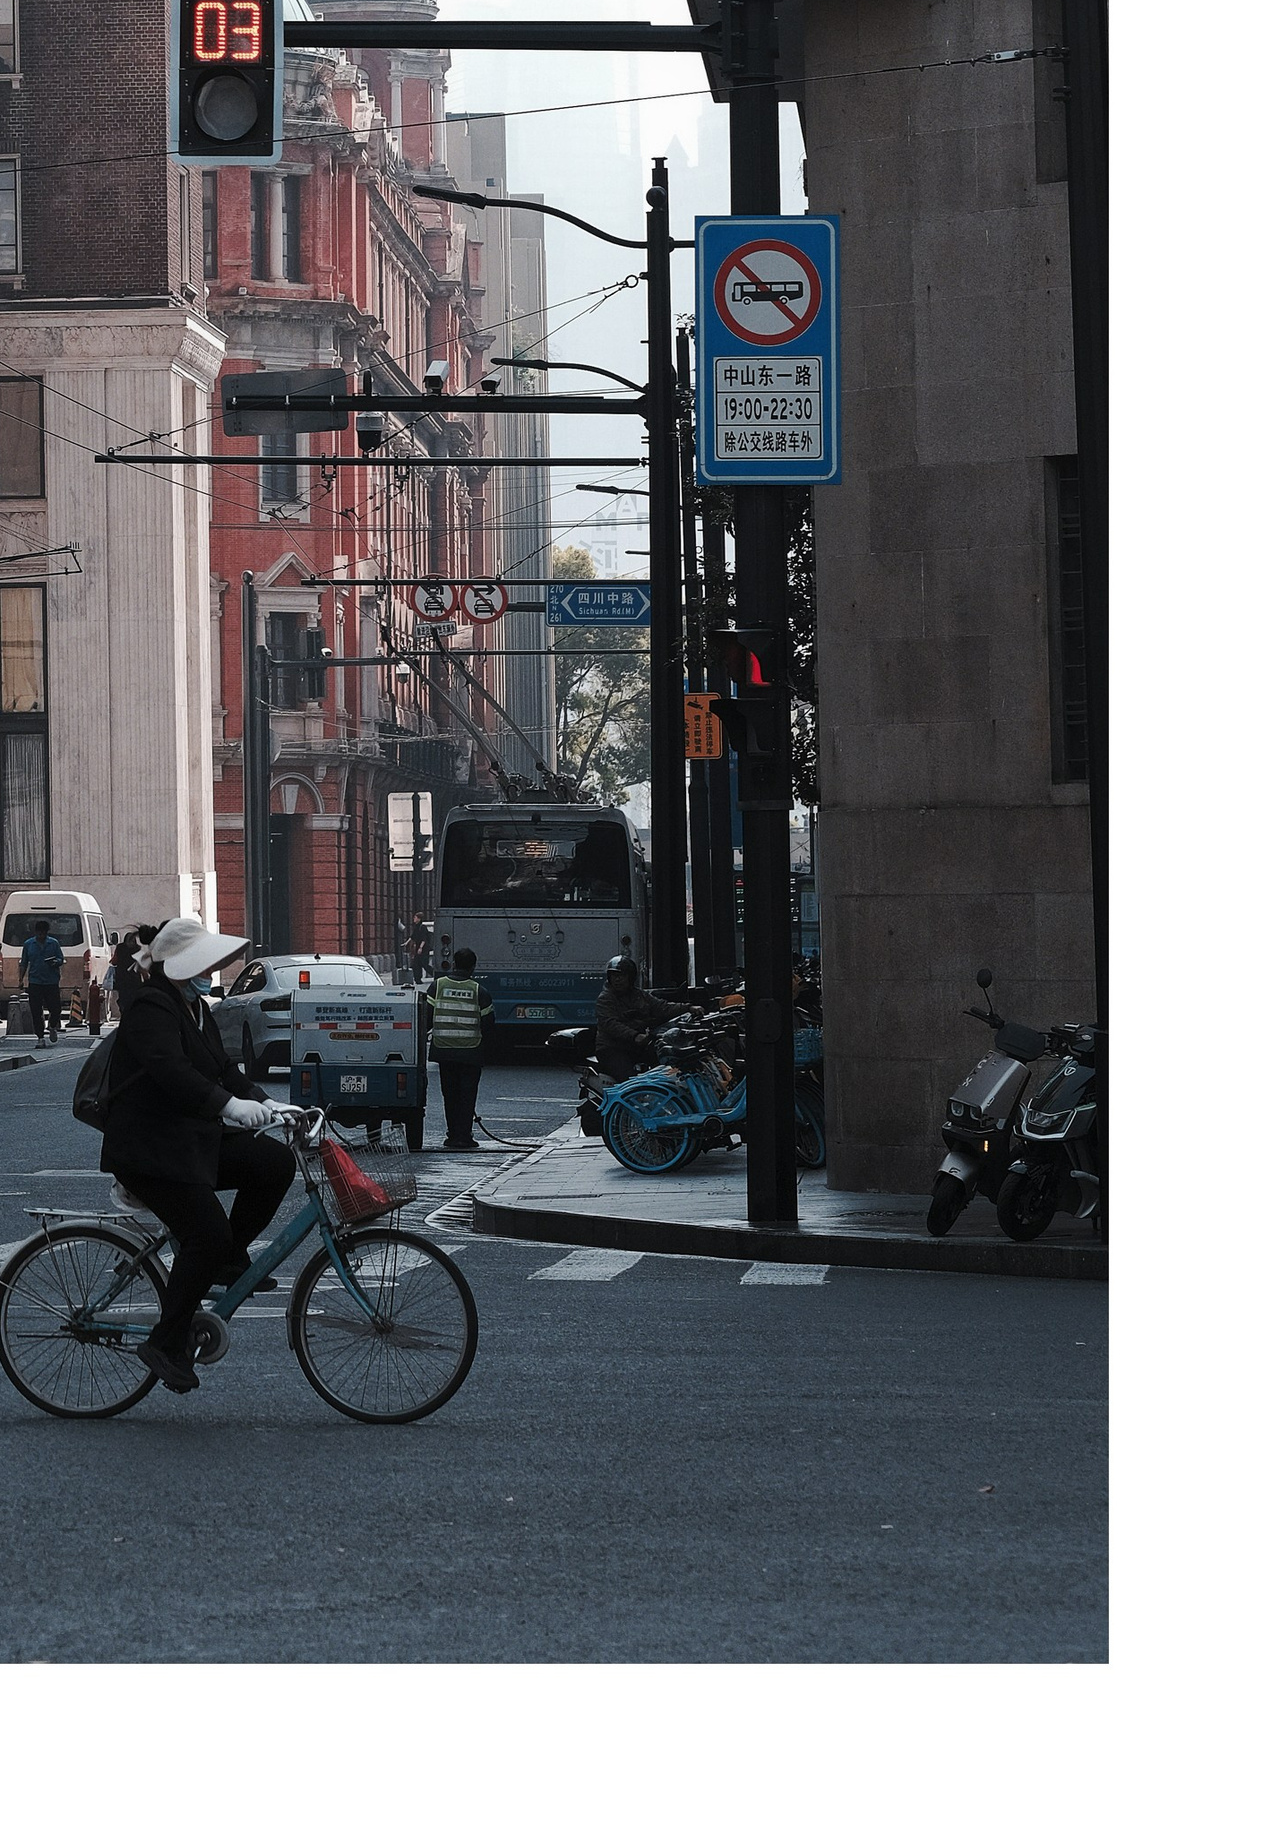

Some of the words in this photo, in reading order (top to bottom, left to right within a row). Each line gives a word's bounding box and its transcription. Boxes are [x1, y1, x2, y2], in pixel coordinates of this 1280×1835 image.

[195, 1, 260, 60] 03
[723, 364, 812, 387] 中山东一路
[724, 397, 813, 420] 19:00-22:30
[724, 431, 813, 453] 除公交线路车外
[550, 584, 564, 594] 270
[550, 595, 559, 605] 北
[578, 592, 634, 605] 四川中路
[578, 607, 609, 615] Sichuan
[549, 613, 562, 622] 261
[341, 1083, 365, 1092] SJ251
